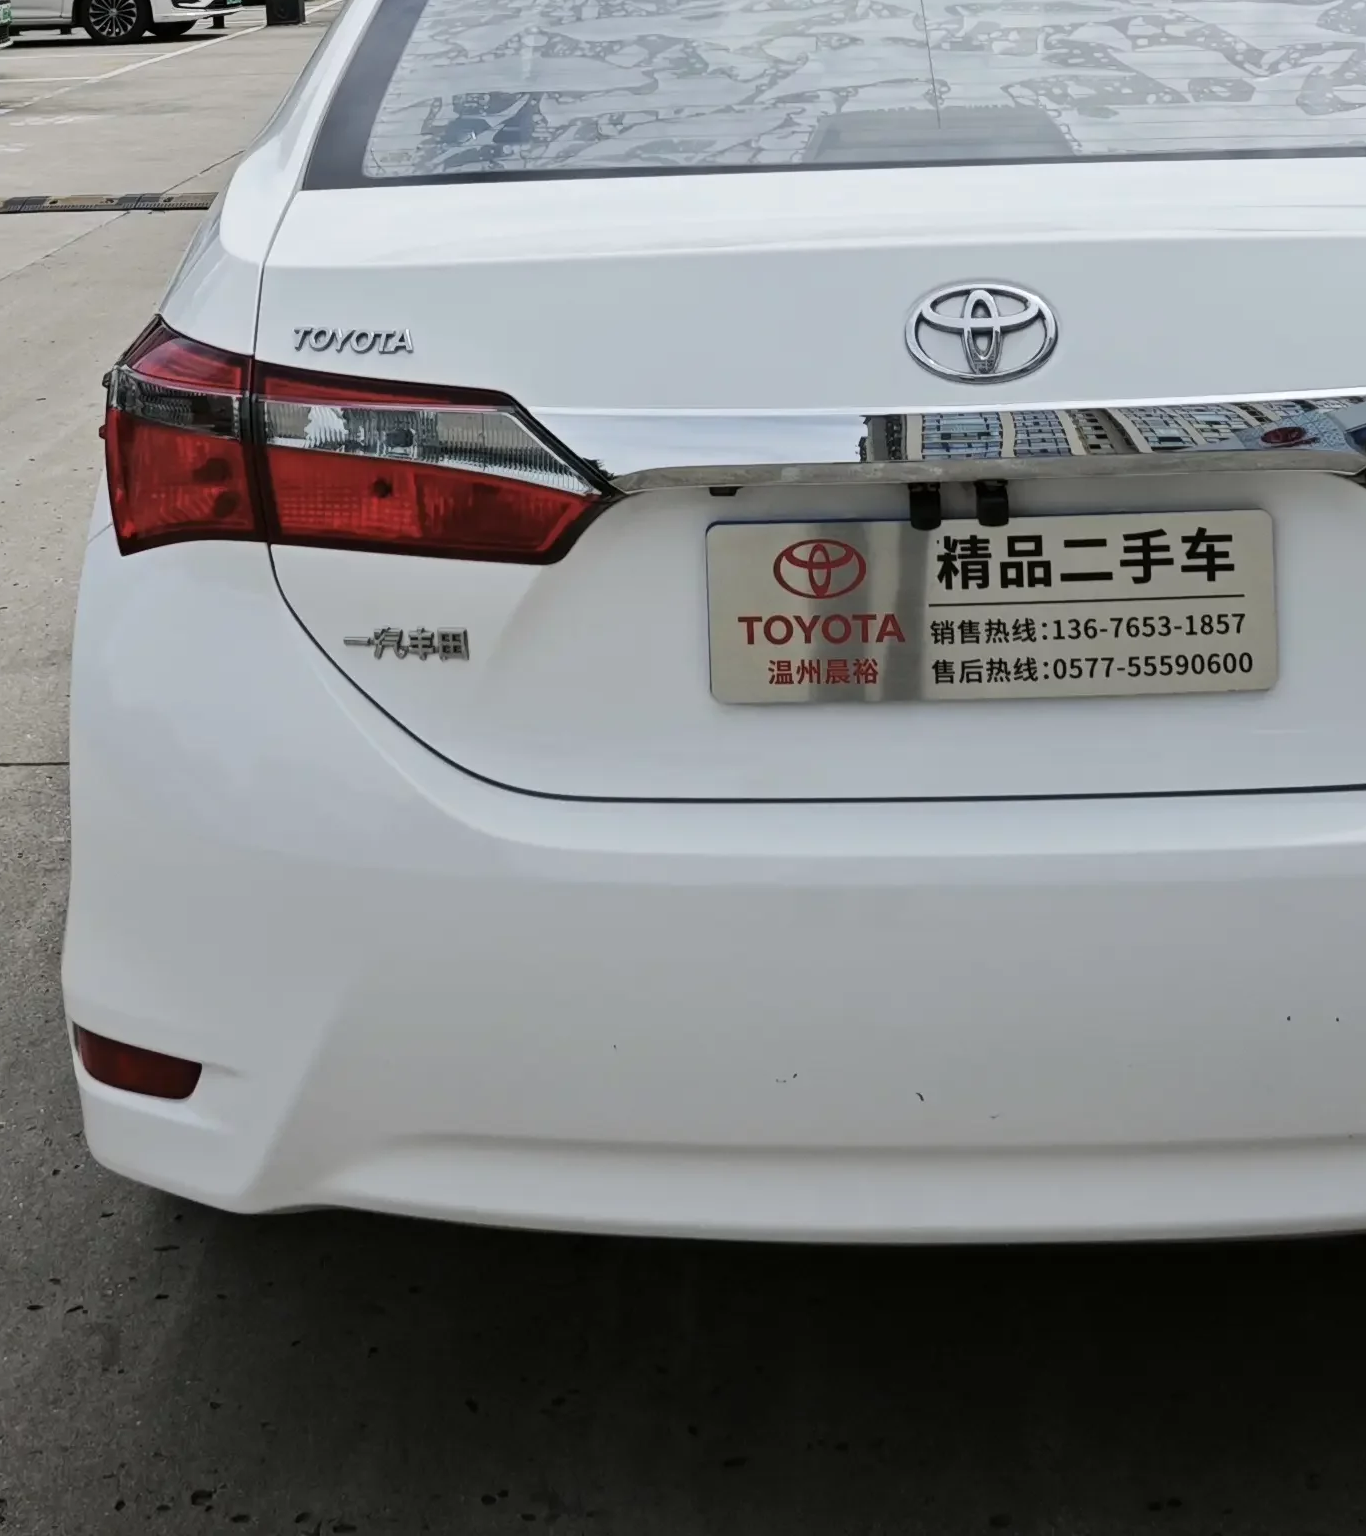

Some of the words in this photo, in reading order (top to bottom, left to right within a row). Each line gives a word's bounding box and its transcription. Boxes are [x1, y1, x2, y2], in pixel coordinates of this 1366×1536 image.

[294, 327, 414, 354] TOYOTA
[936, 526, 1237, 592] 精品二手车
[343, 626, 471, 661] 一汽丰田
[737, 613, 906, 646] TOYOTA
[767, 658, 879, 686] 温州晨裕
